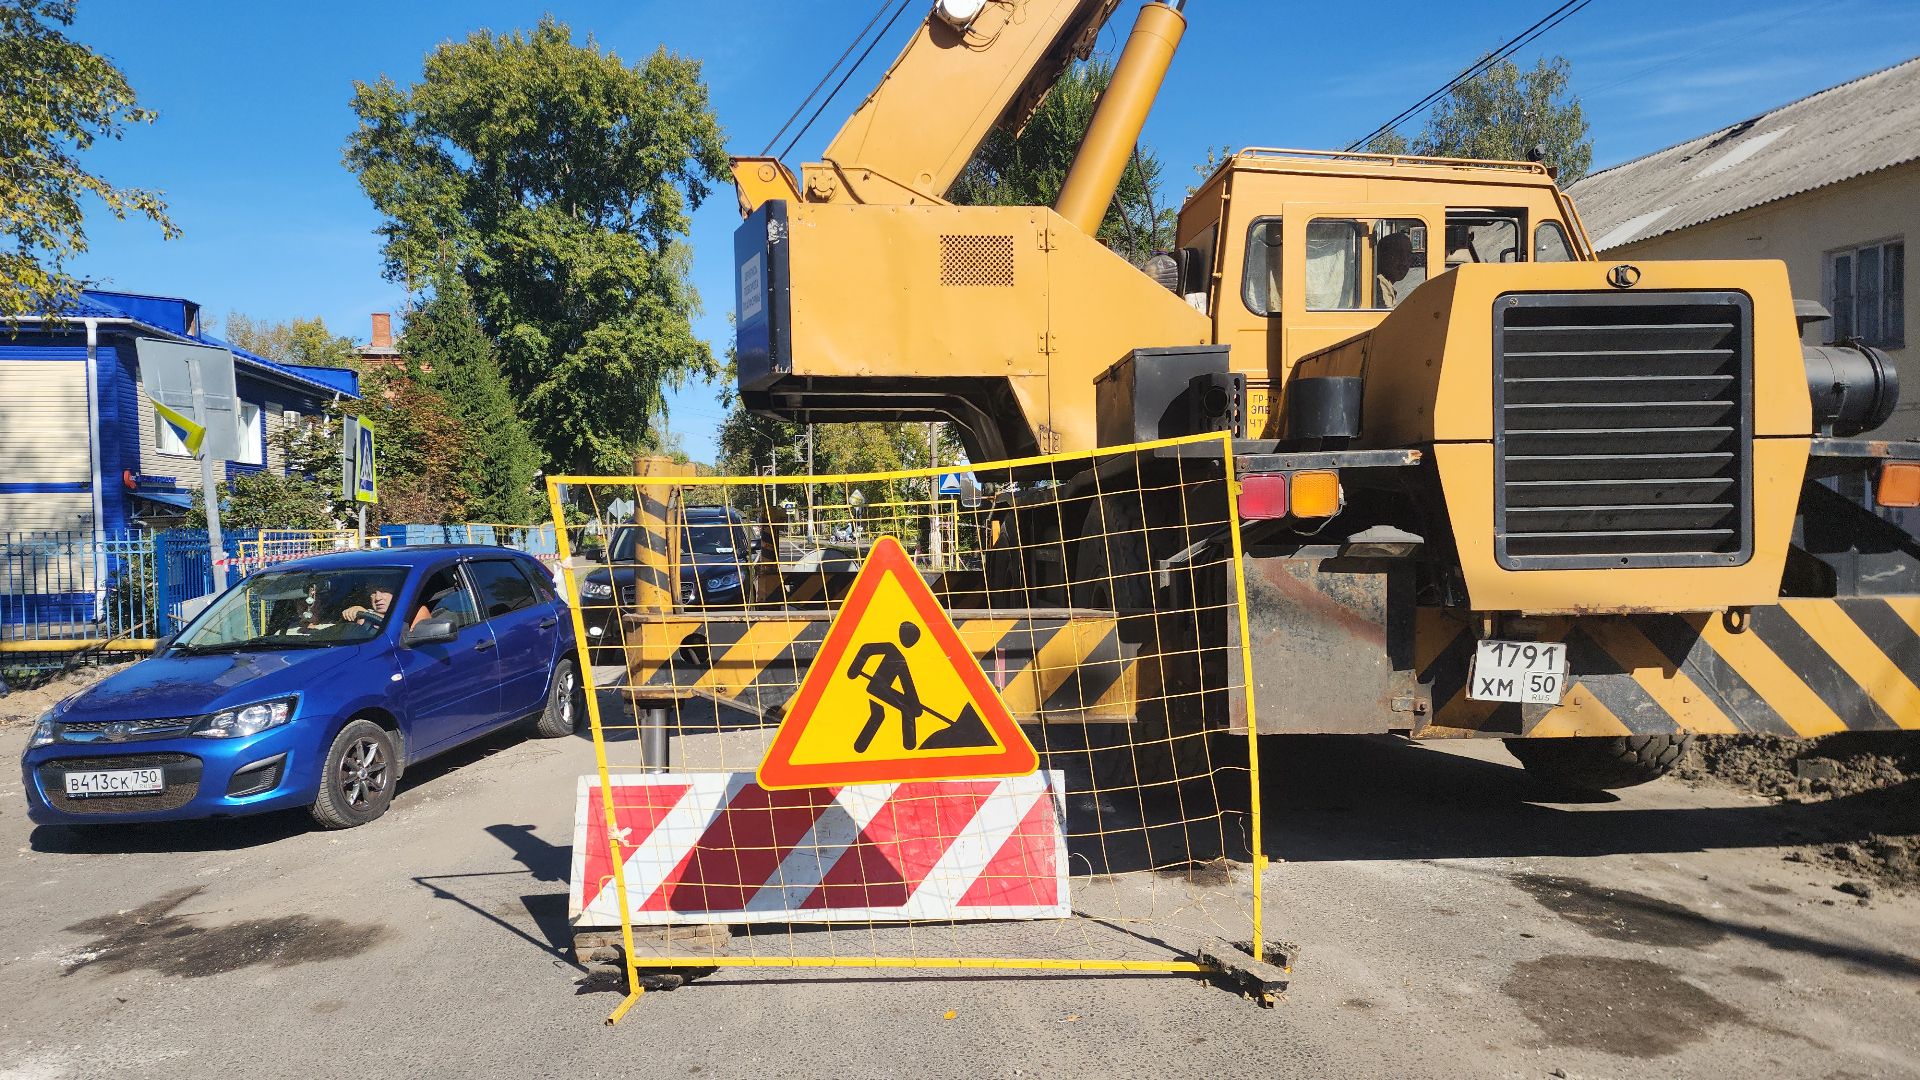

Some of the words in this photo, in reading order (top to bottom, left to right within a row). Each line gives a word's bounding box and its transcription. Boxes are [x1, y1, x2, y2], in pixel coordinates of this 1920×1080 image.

[1490, 643, 1554, 670] 1791
[1479, 677, 1514, 697] ХМ
[1530, 675, 1556, 693] 50
[71, 773, 129, 791] В413СК
[132, 770, 157, 784] 750
